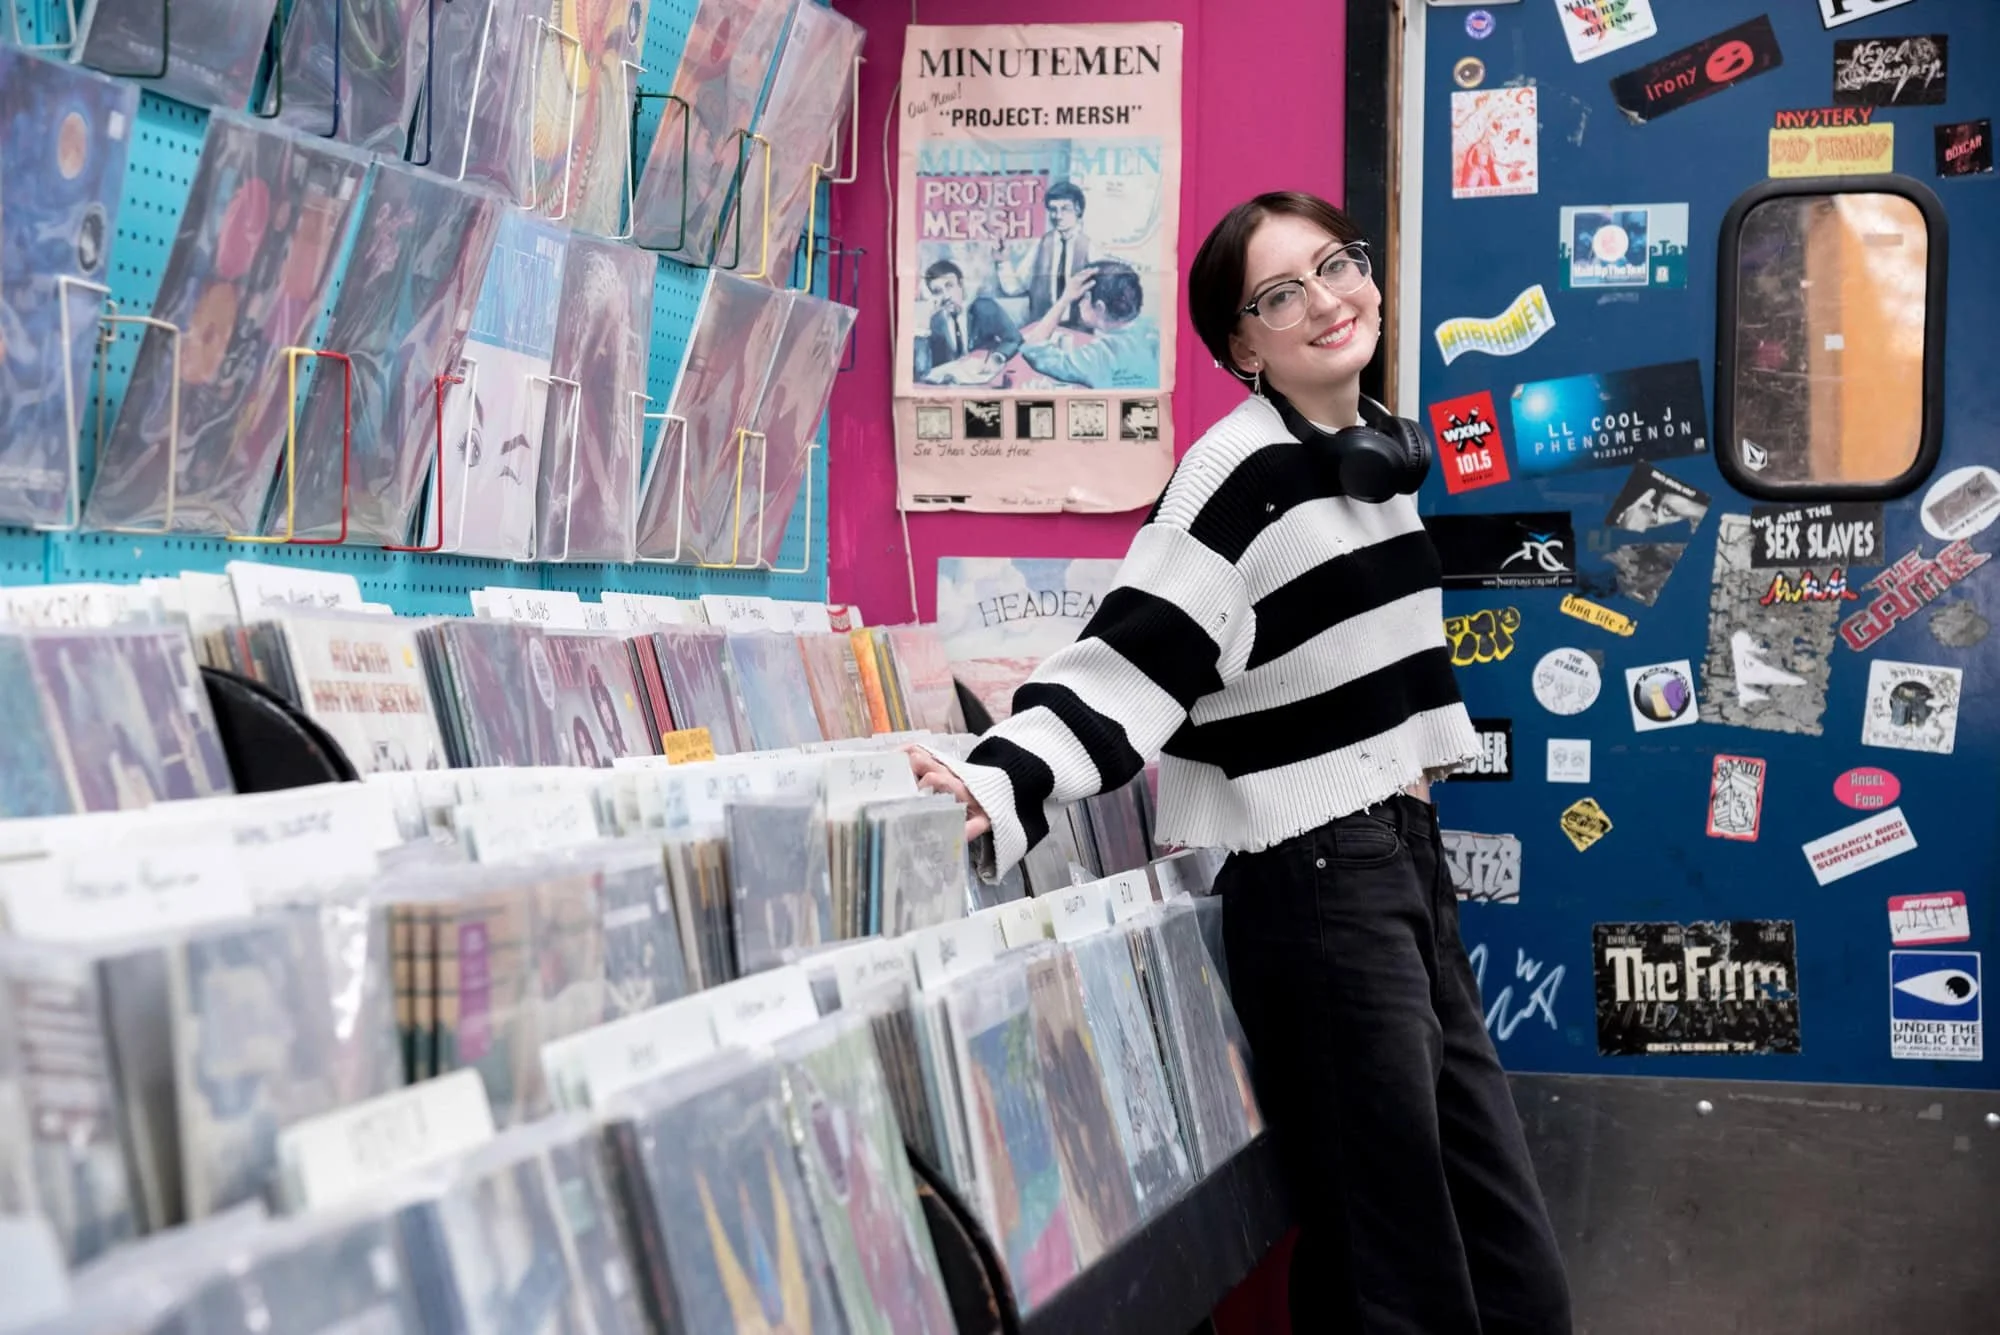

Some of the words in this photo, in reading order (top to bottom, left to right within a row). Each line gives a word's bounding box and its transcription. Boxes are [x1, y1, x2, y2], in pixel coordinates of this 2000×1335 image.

[1580, 12, 1634, 37] RACISM
[919, 44, 1162, 78] MINUTEMEN
[907, 101, 929, 119] Out
[931, 82, 962, 107] Now!
[939, 107, 1049, 128] "PROJECT:
[1056, 105, 1142, 125] MERSH"
[1775, 107, 1873, 128] MYSTERY
[1945, 134, 1982, 162] BOXCAR
[925, 180, 1041, 208] PROJECT
[923, 209, 1032, 239] MERSH
[1440, 292, 1549, 354] MUDHONEY
[1443, 421, 1491, 442] WXNA
[1548, 423, 1573, 438] LL
[1592, 410, 1644, 432] COOL
[1663, 406, 1672, 422] J
[1535, 421, 1692, 455] PHENOMENON
[1456, 449, 1492, 475] 101.5
[1752, 515, 1774, 529] WE
[1777, 510, 1802, 524] ARE
[1806, 504, 1833, 518] THE
[1765, 522, 1800, 559] SEX
[1807, 521, 1875, 560] SLAVES
[1864, 544, 1928, 593] THE
[978, 590, 1097, 627] HEADEA
[1839, 539, 1992, 651] GAME
[1568, 653, 1584, 665] THE
[1812, 832, 1873, 862] RESEARCH
[1875, 820, 1903, 836] BIRD
[1816, 828, 1907, 870] SURVEILLANCE
[1605, 947, 1679, 1001] The
[1893, 1022, 1945, 1034] UNDER
[1951, 1023, 1978, 1035] THE
[1893, 1034, 1947, 1045] PUBLIC
[1952, 1035, 1978, 1046] EYE
